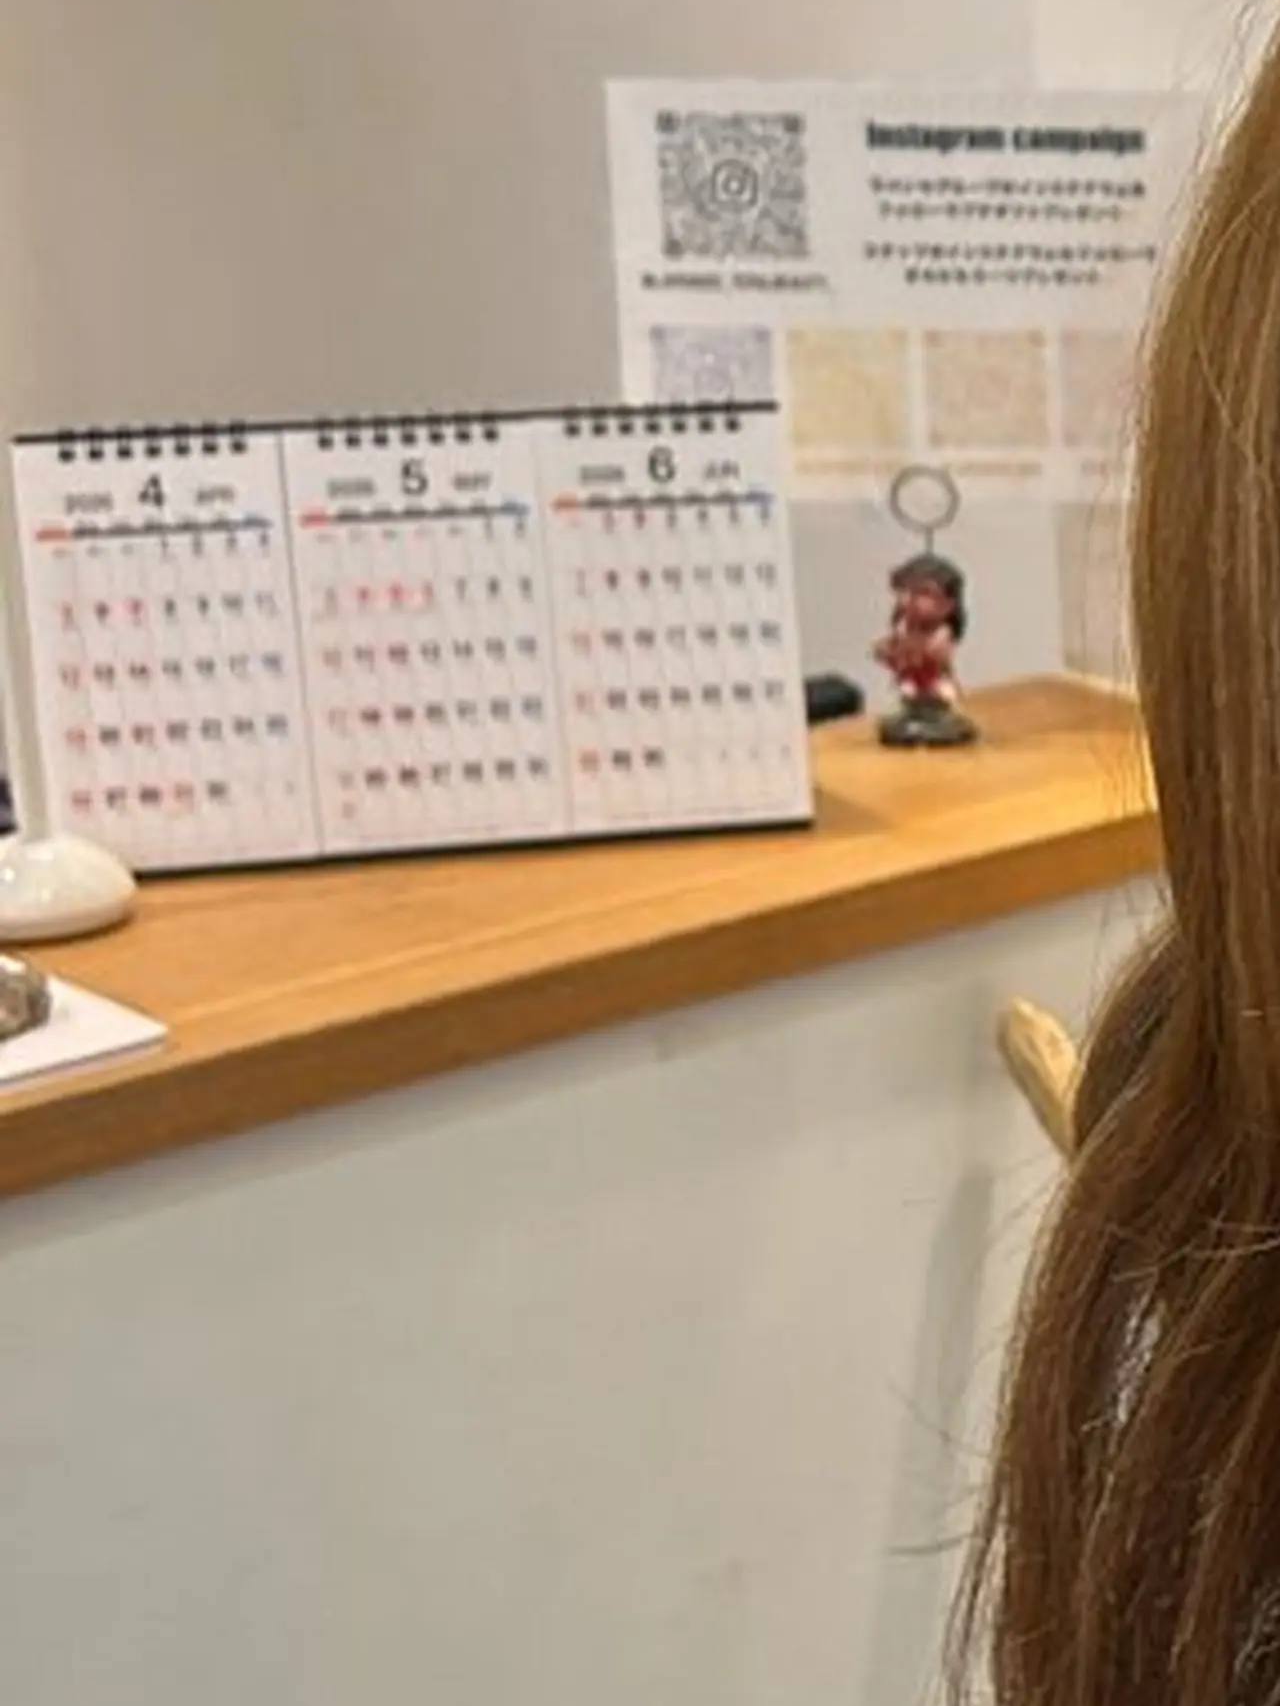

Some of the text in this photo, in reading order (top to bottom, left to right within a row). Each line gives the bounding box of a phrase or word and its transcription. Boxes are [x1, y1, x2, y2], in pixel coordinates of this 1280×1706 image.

[866, 119, 1145, 156] Instagram campaign
[401, 458, 429, 496] 5
[648, 445, 676, 484] 6
[138, 473, 164, 507] 4
